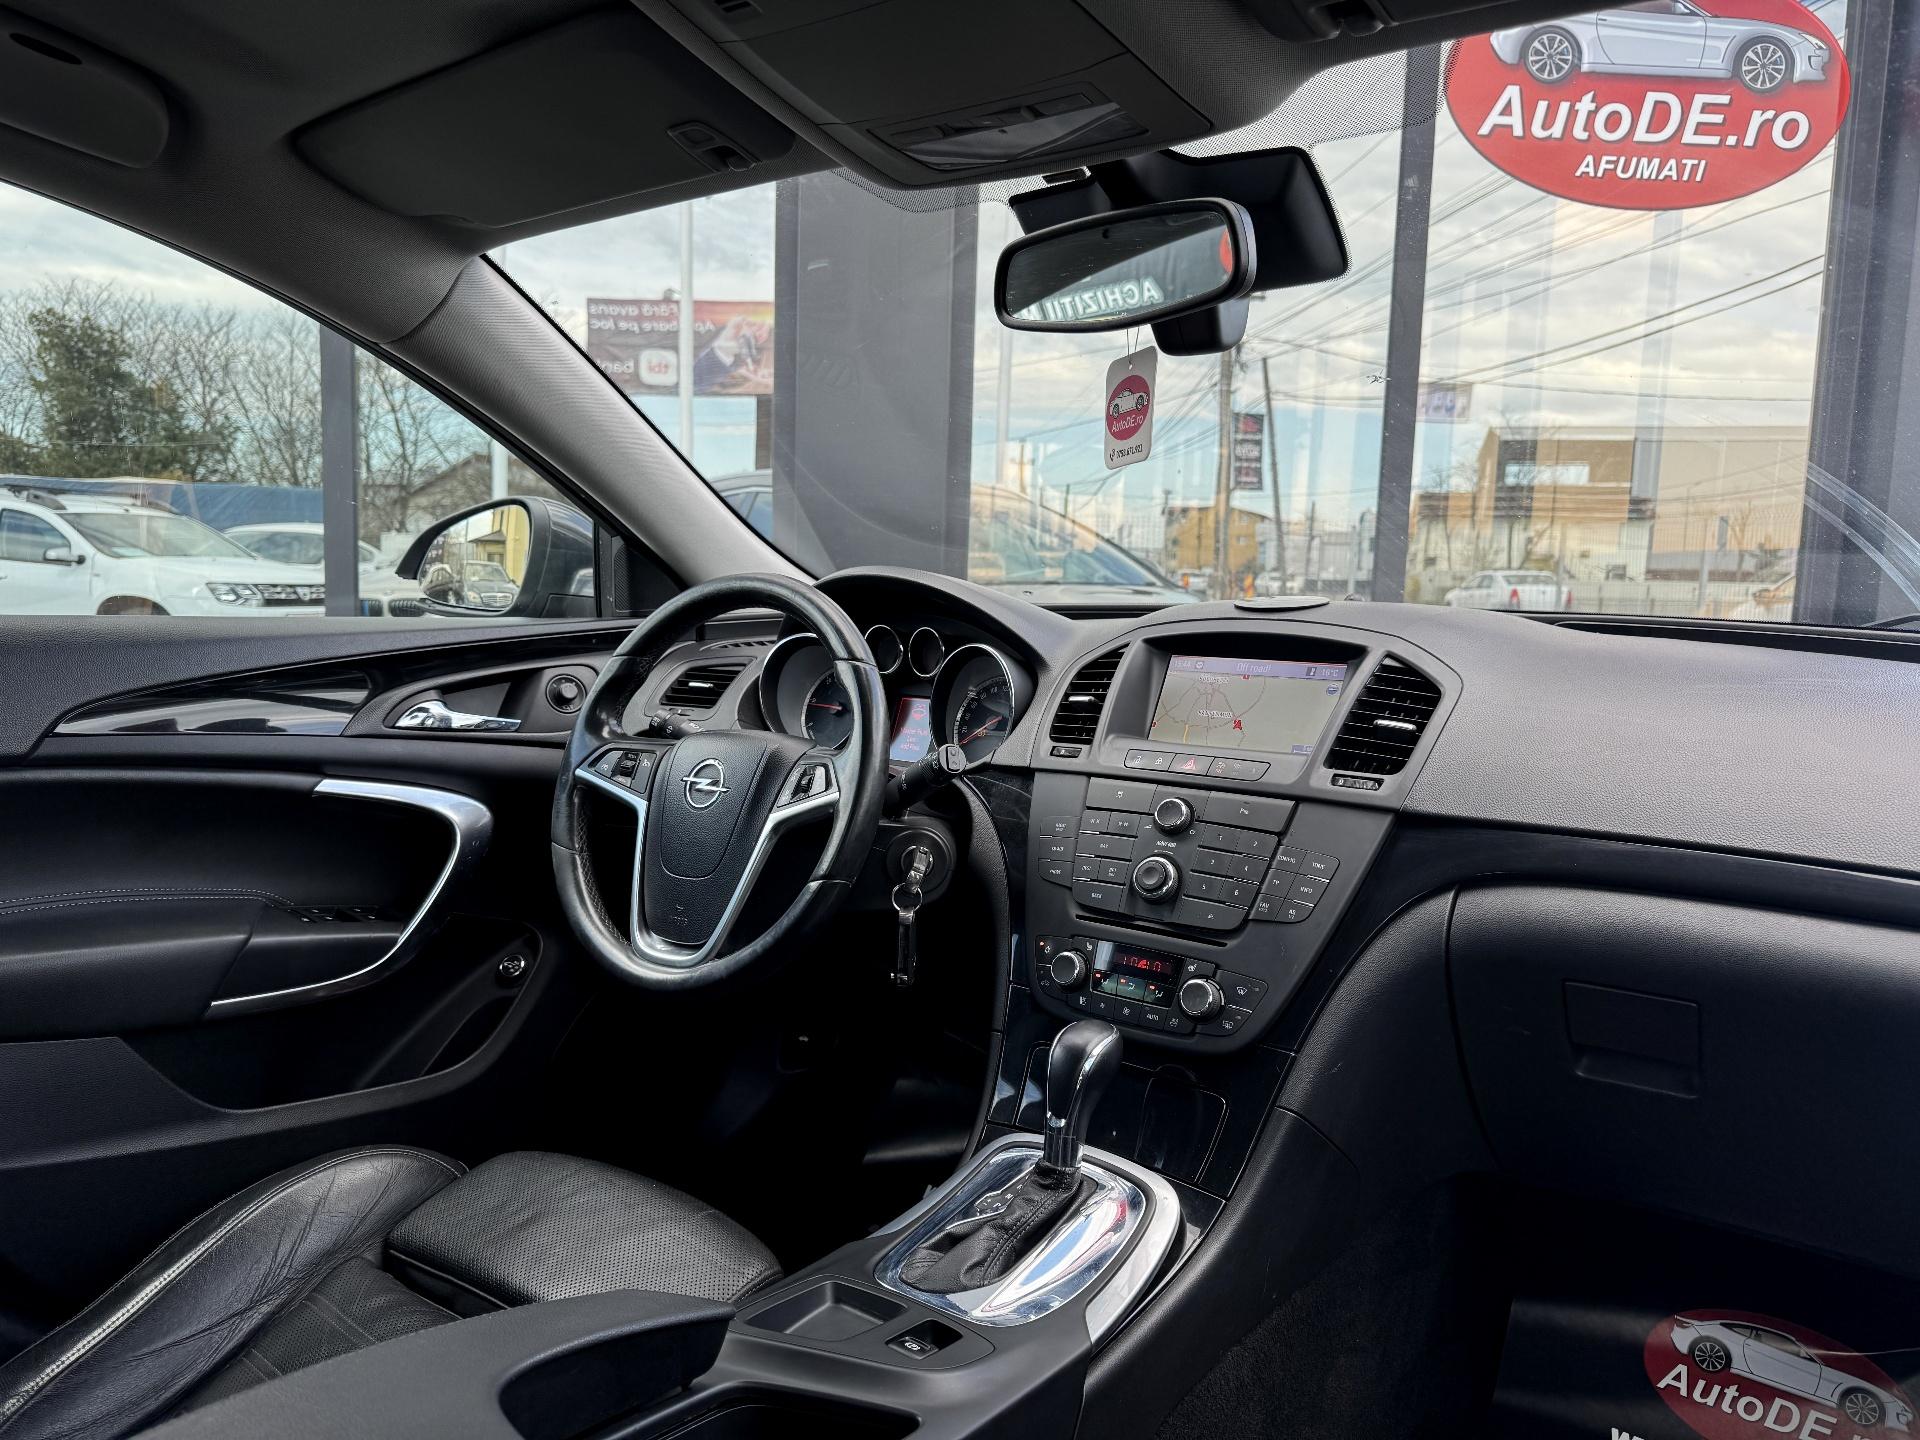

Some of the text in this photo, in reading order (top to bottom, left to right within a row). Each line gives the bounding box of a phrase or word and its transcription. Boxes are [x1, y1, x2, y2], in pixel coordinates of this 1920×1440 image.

[1477, 84, 1811, 150] AutoDE.ro
[1575, 154, 1707, 182] AFUMATI
[1111, 415, 1144, 433] AutoDE.ro
